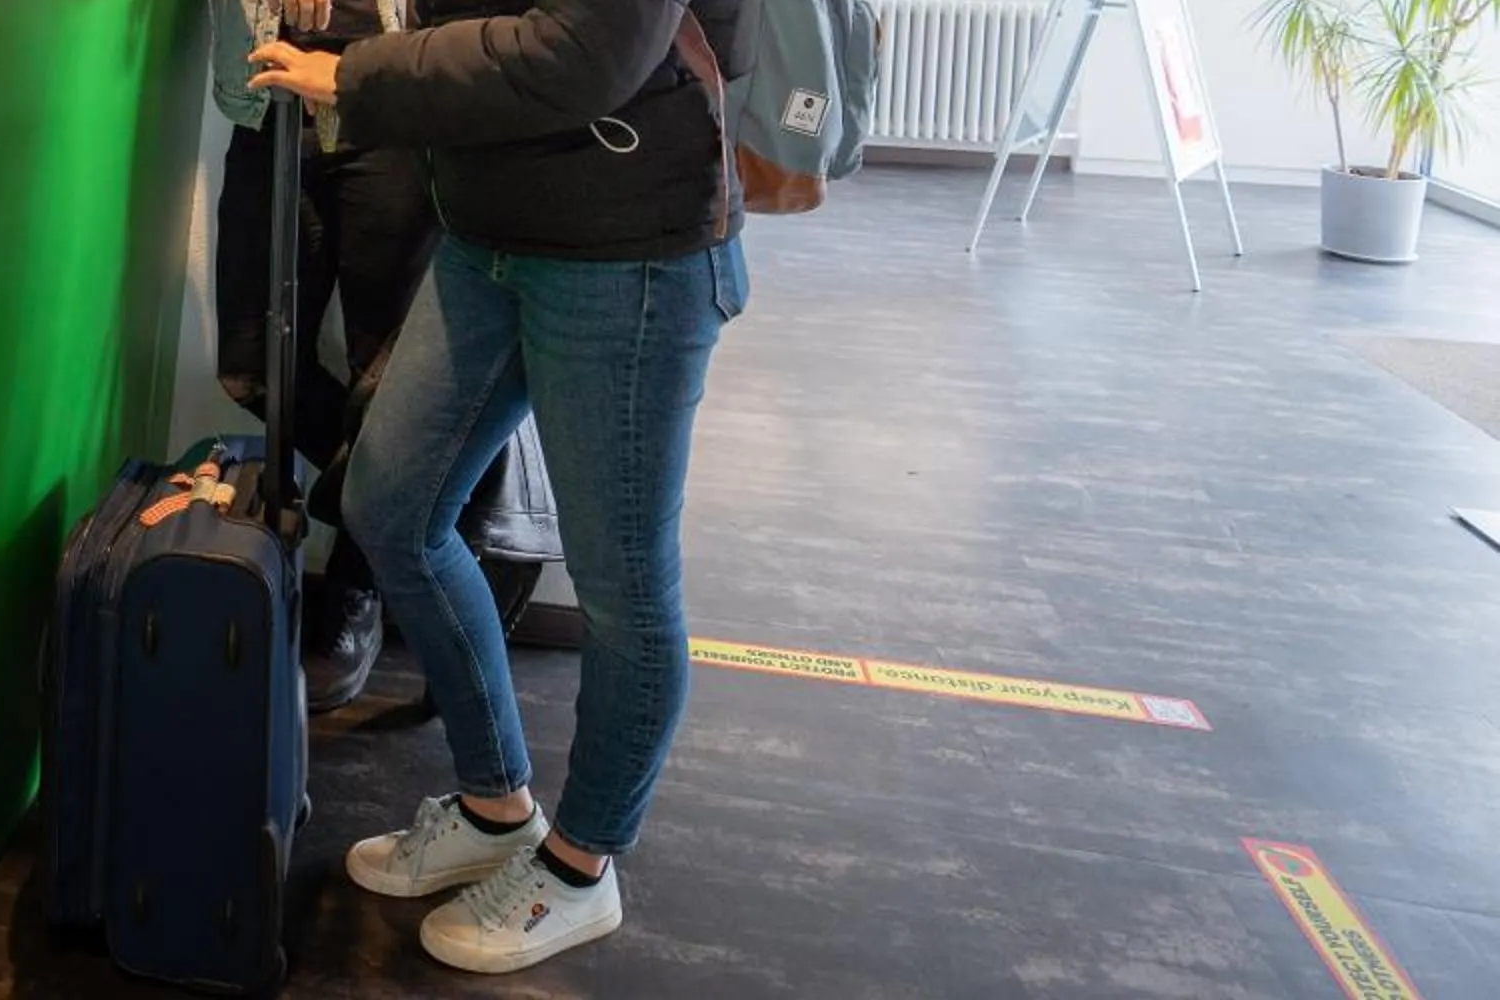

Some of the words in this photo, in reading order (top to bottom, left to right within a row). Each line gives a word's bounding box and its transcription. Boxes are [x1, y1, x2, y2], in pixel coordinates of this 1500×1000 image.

[691, 649, 776, 667] YOURSELF
[816, 657, 853, 669] AND
[779, 661, 857, 678] PROTECT
[1001, 683, 1061, 701] your
[1064, 691, 1133, 711] Keep
